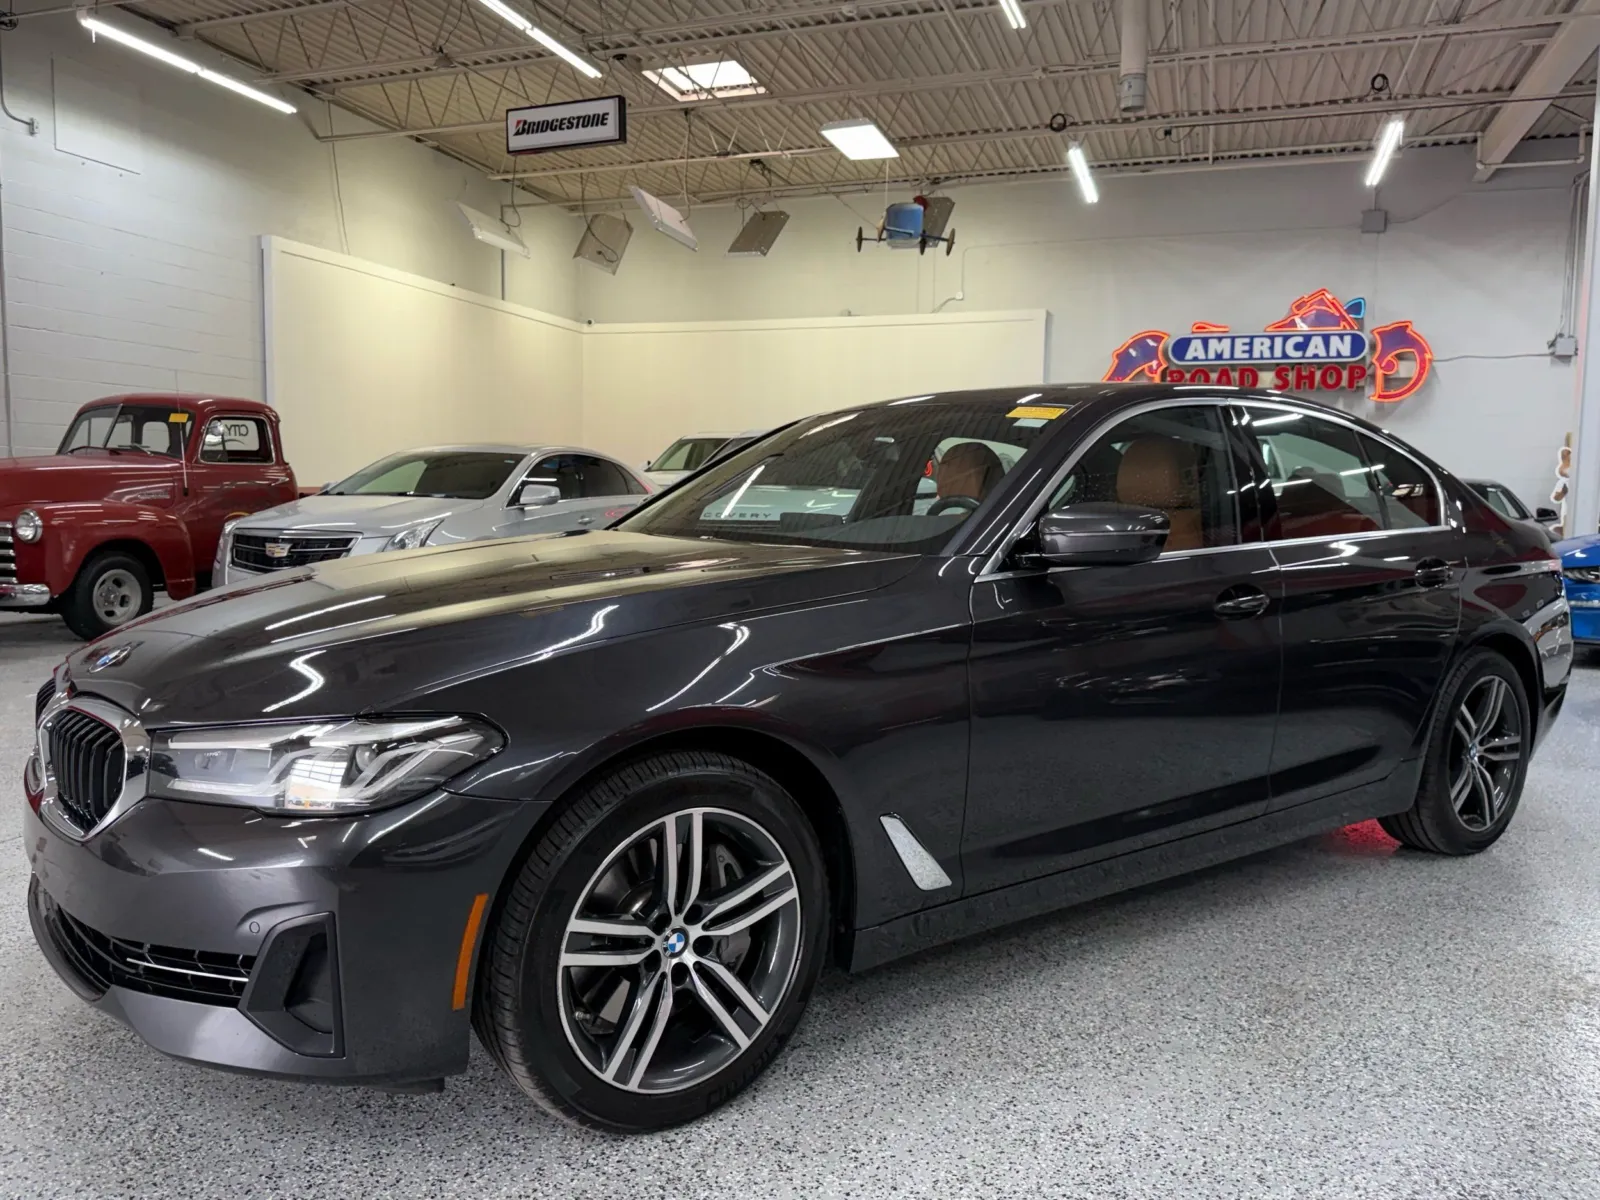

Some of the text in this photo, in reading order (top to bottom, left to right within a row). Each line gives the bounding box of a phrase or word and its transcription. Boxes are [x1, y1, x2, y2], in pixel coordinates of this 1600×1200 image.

[513, 112, 609, 136] BRIDGESTONE
[1184, 335, 1352, 360] AMERICAN
[1273, 364, 1368, 391] SHOP
